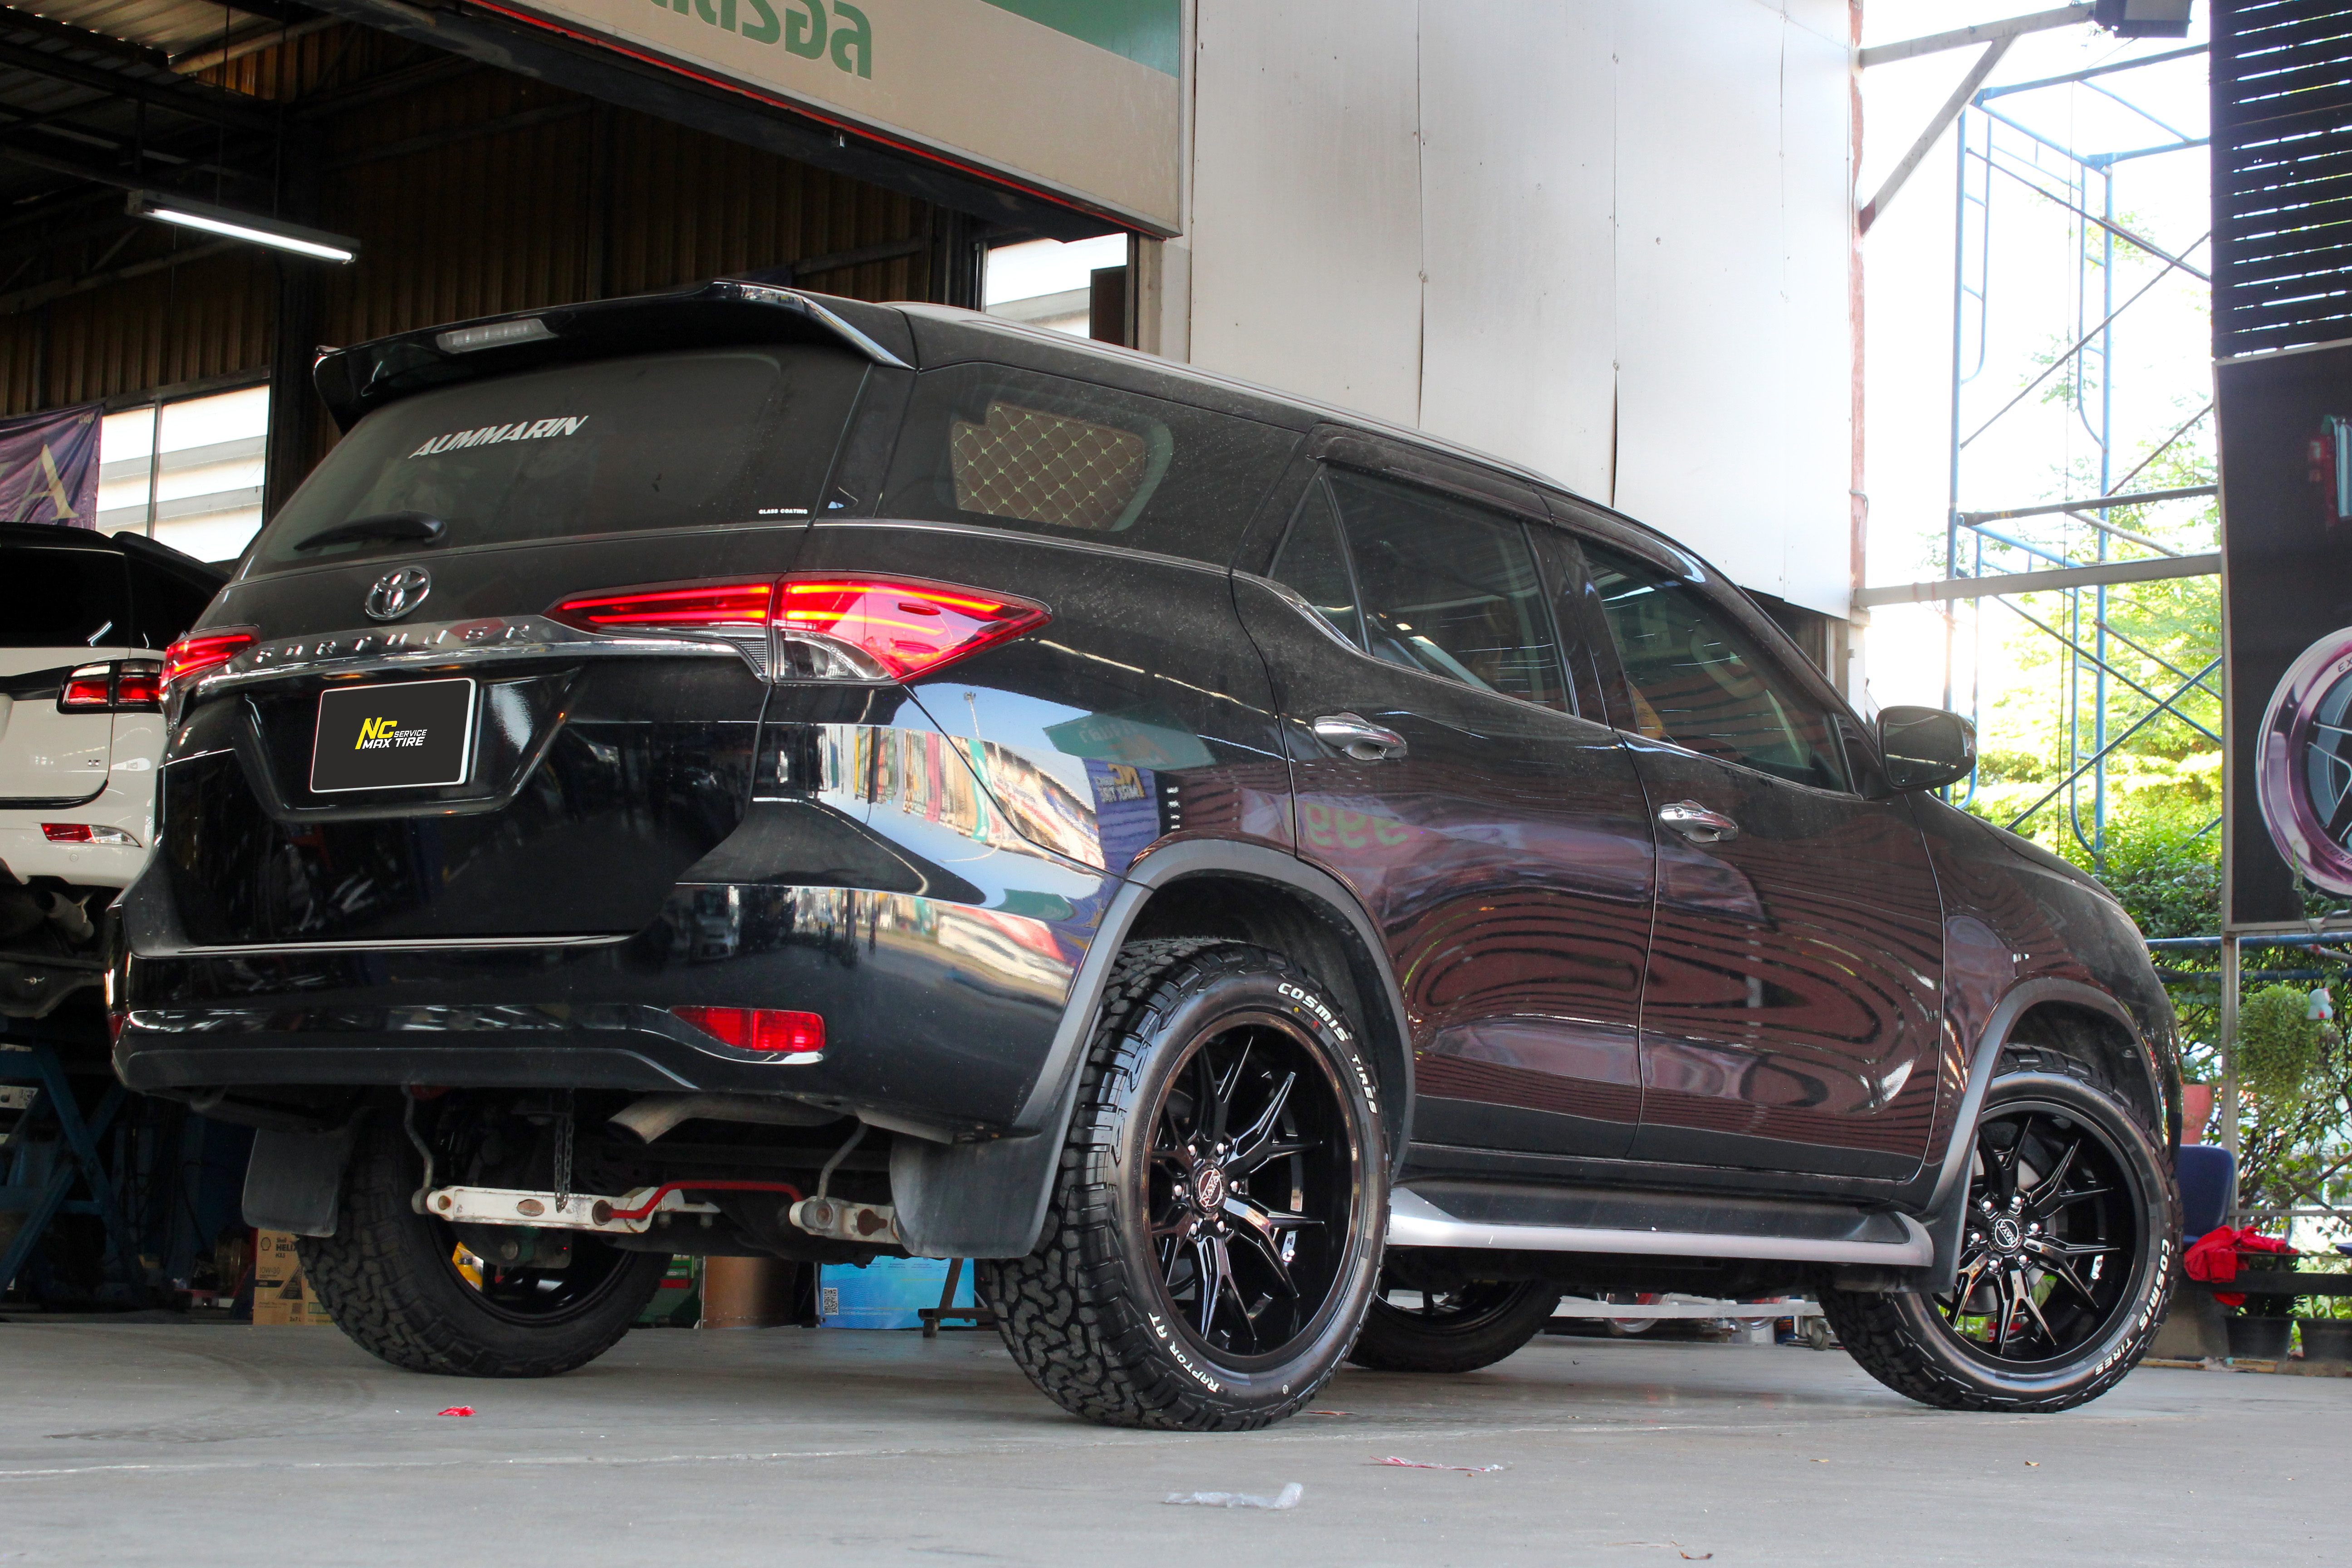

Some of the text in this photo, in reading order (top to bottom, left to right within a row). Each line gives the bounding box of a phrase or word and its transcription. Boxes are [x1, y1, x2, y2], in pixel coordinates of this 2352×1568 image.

[647, 0, 872, 80] รอล
[408, 415, 589, 459] AUMMARIN
[1278, 982, 1349, 1041] COSMIS
[1351, 1054, 1377, 1113] TIRES
[2138, 1239, 2170, 1331] COSMIS
[1169, 1341, 1220, 1392] RAPTOR
[2095, 1338, 2133, 1375] TIRES
